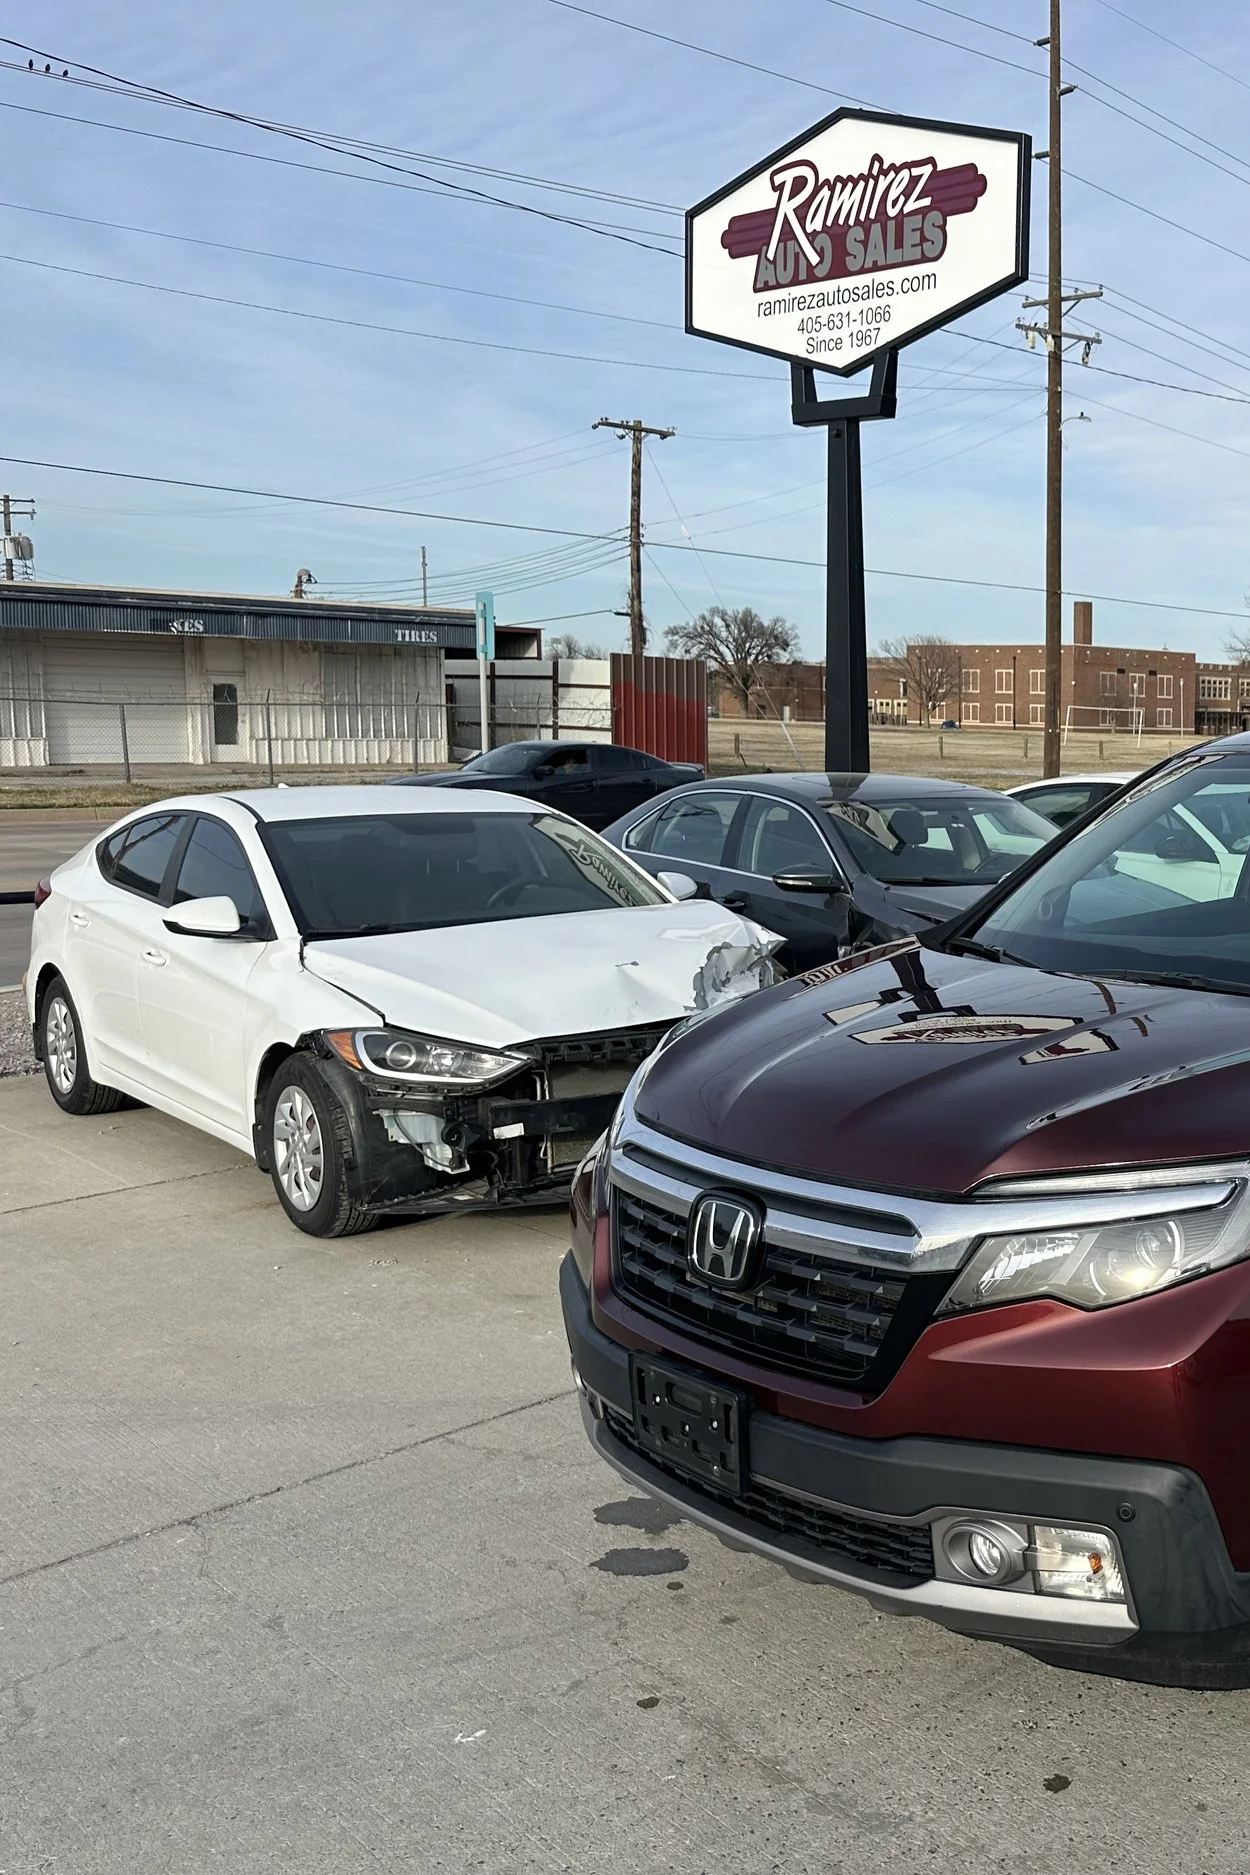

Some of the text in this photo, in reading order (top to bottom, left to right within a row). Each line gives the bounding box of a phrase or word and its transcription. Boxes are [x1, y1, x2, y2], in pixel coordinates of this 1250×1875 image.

[766, 159, 934, 267] Ramirez
[755, 210, 944, 289] AUTO SALES
[757, 272, 938, 318] ramirezautosales.com
[797, 304, 892, 335] 405-631-1066
[805, 327, 882, 355] Since 1967
[394, 629, 438, 643] TIRES
